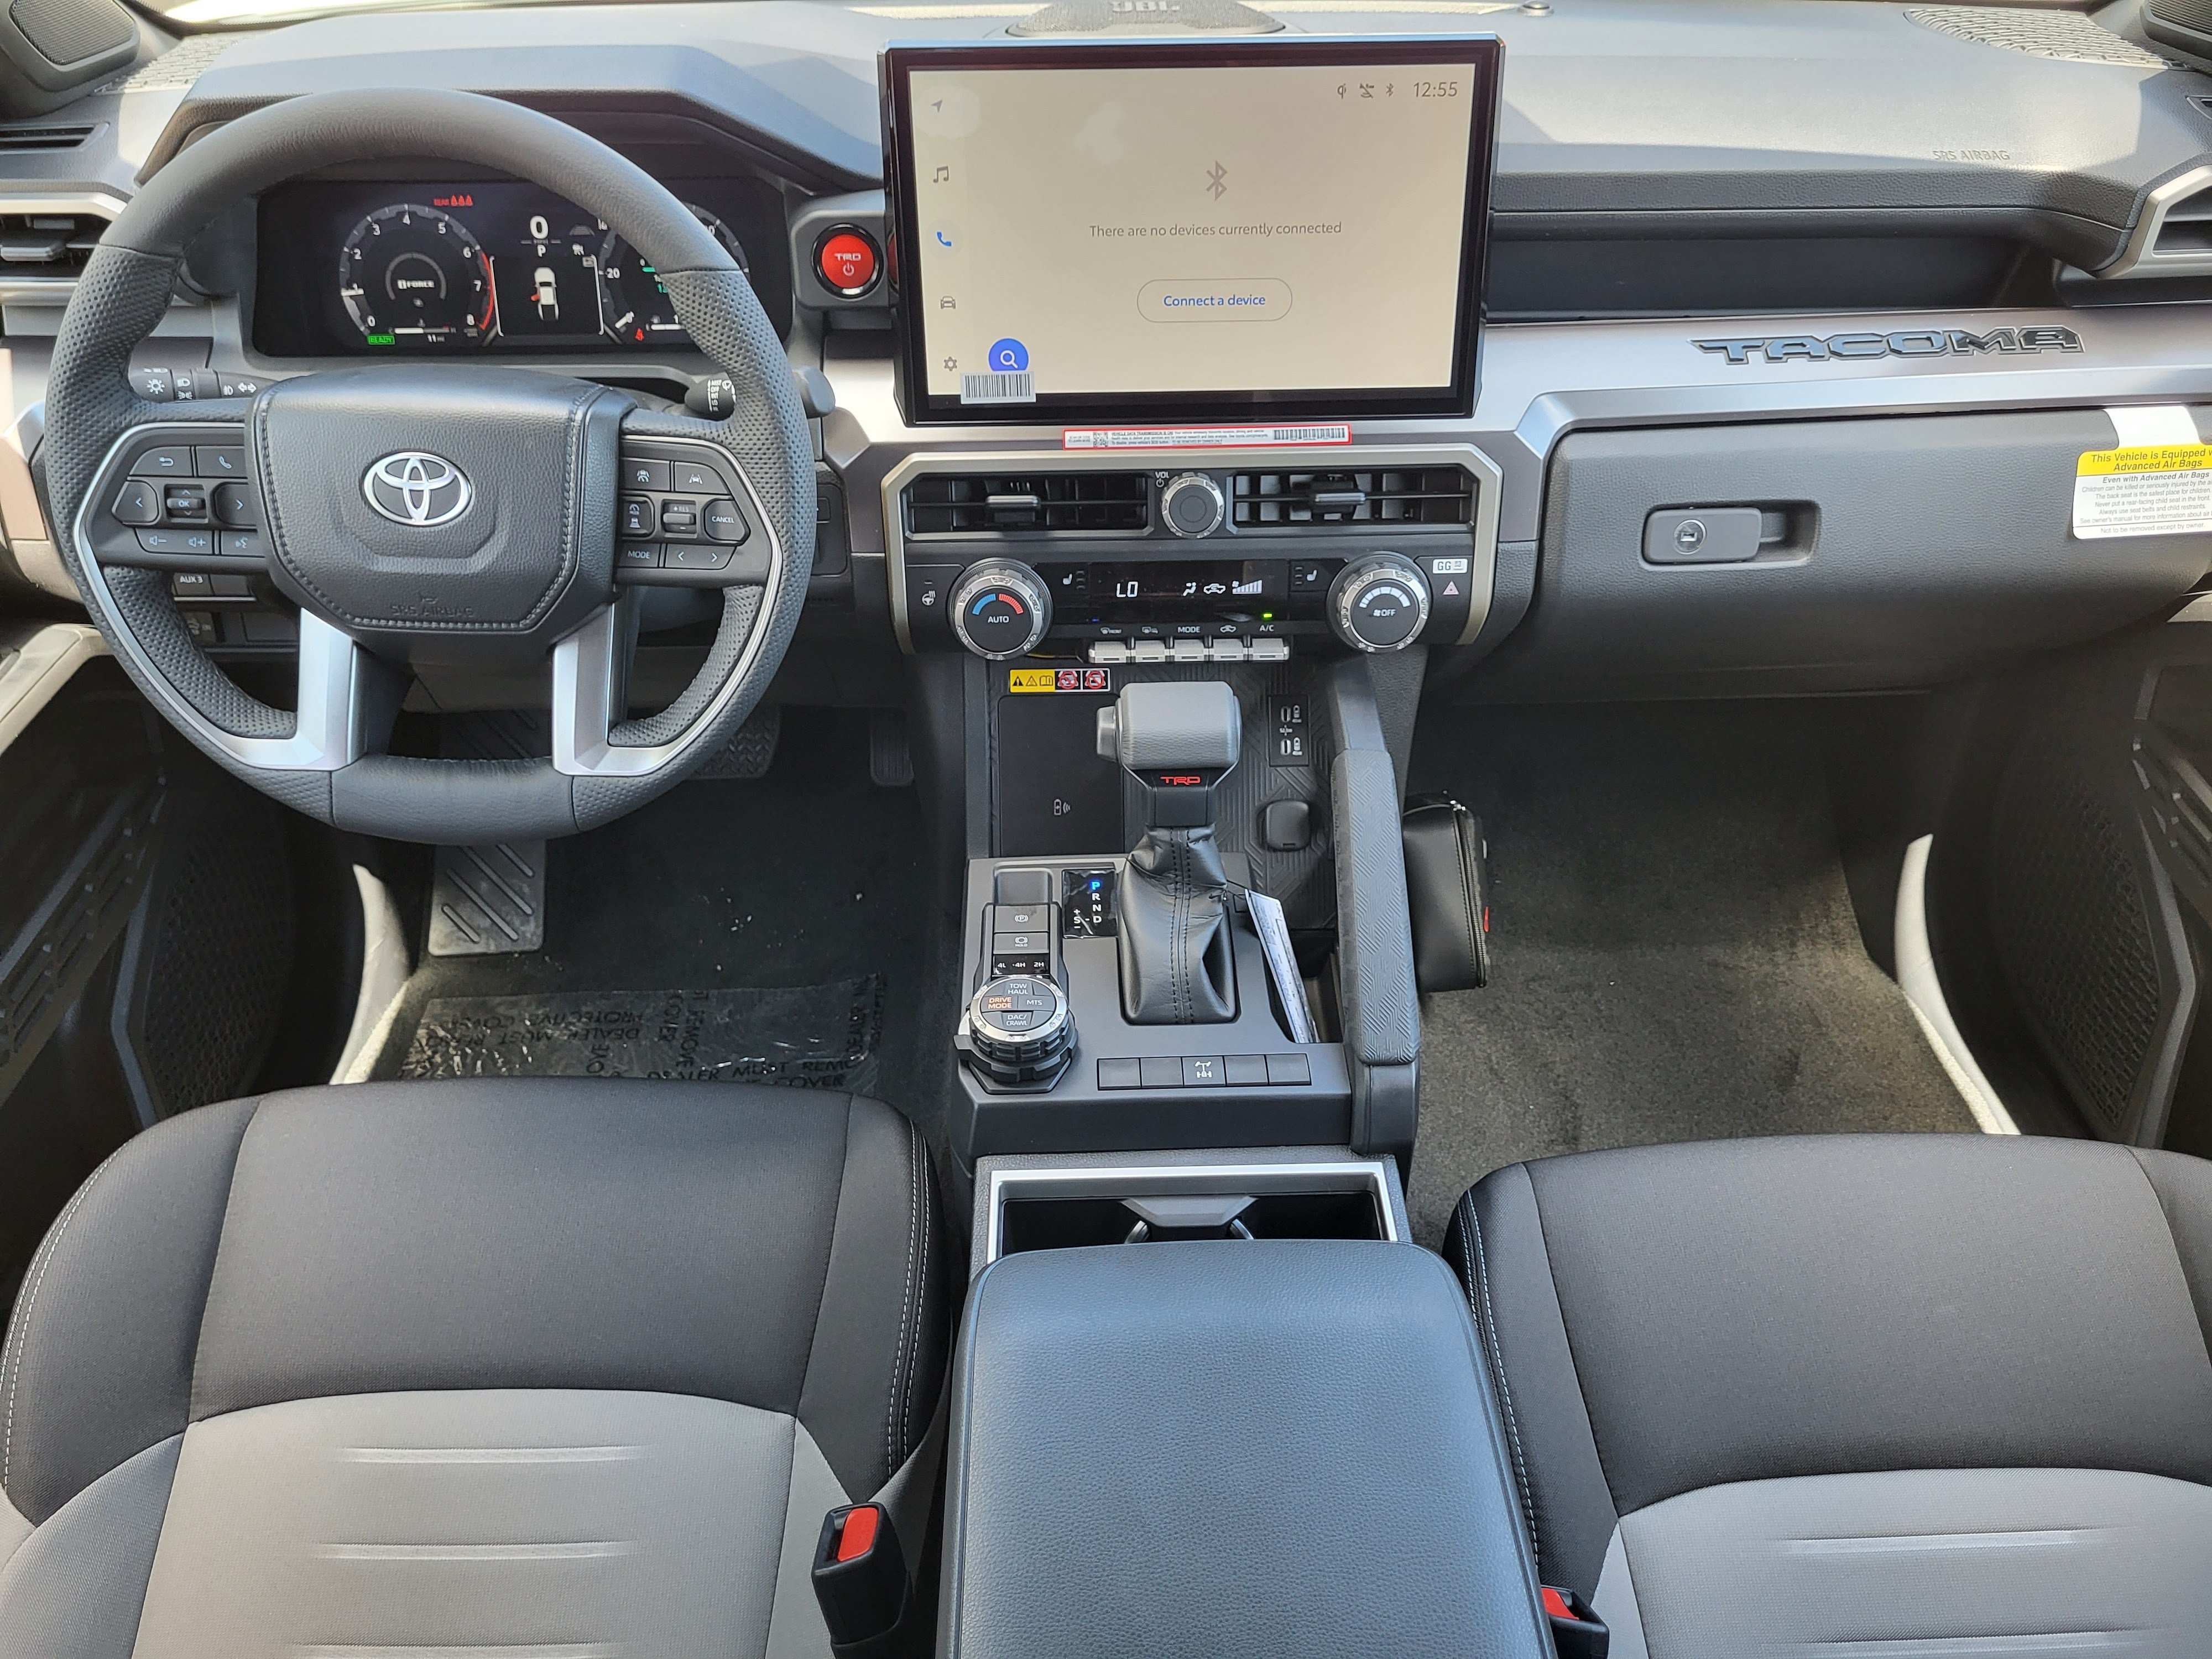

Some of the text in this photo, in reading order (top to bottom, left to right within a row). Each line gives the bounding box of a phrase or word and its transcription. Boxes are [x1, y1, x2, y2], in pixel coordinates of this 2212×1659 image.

[1413, 81, 1458, 97] 12:55
[1932, 149, 2011, 160] SRS AIRBAG
[372, 223, 380, 236] 3
[437, 221, 446, 234] 5
[529, 215, 549, 239] 0
[1089, 222, 1342, 237] There are no devices currently connected
[353, 248, 362, 260] 2
[462, 246, 472, 258] 6
[537, 244, 546, 257] P
[834, 253, 862, 262] TRD
[606, 268, 620, 279] 20
[473, 279, 482, 292] 7
[1163, 294, 1266, 307] Connect a device
[367, 315, 376, 327] 0
[466, 313, 475, 326] 8
[1689, 325, 2085, 365] TACOMA
[2091, 453, 2111, 463] This
[2115, 452, 2148, 461] Vehicle
[2150, 451, 2158, 460] is
[2161, 448, 2206, 460] Equipped
[2113, 460, 2203, 471] Advanced Air Bags
[2140, 473, 2177, 481] Advanced
[2171, 480, 2189, 488] injured
[178, 500, 190, 508] OK
[628, 550, 650, 559] MODE
[1438, 561, 1452, 571] GG
[180, 575, 204, 583] AUX 3
[1116, 581, 1139, 598] LO
[987, 615, 1010, 624] AUTO
[1160, 776, 1201, 785] TRD
[1092, 881, 1101, 890] P
[1092, 893, 1101, 901] R
[1092, 904, 1102, 912] N
[1073, 916, 1081, 924] S
